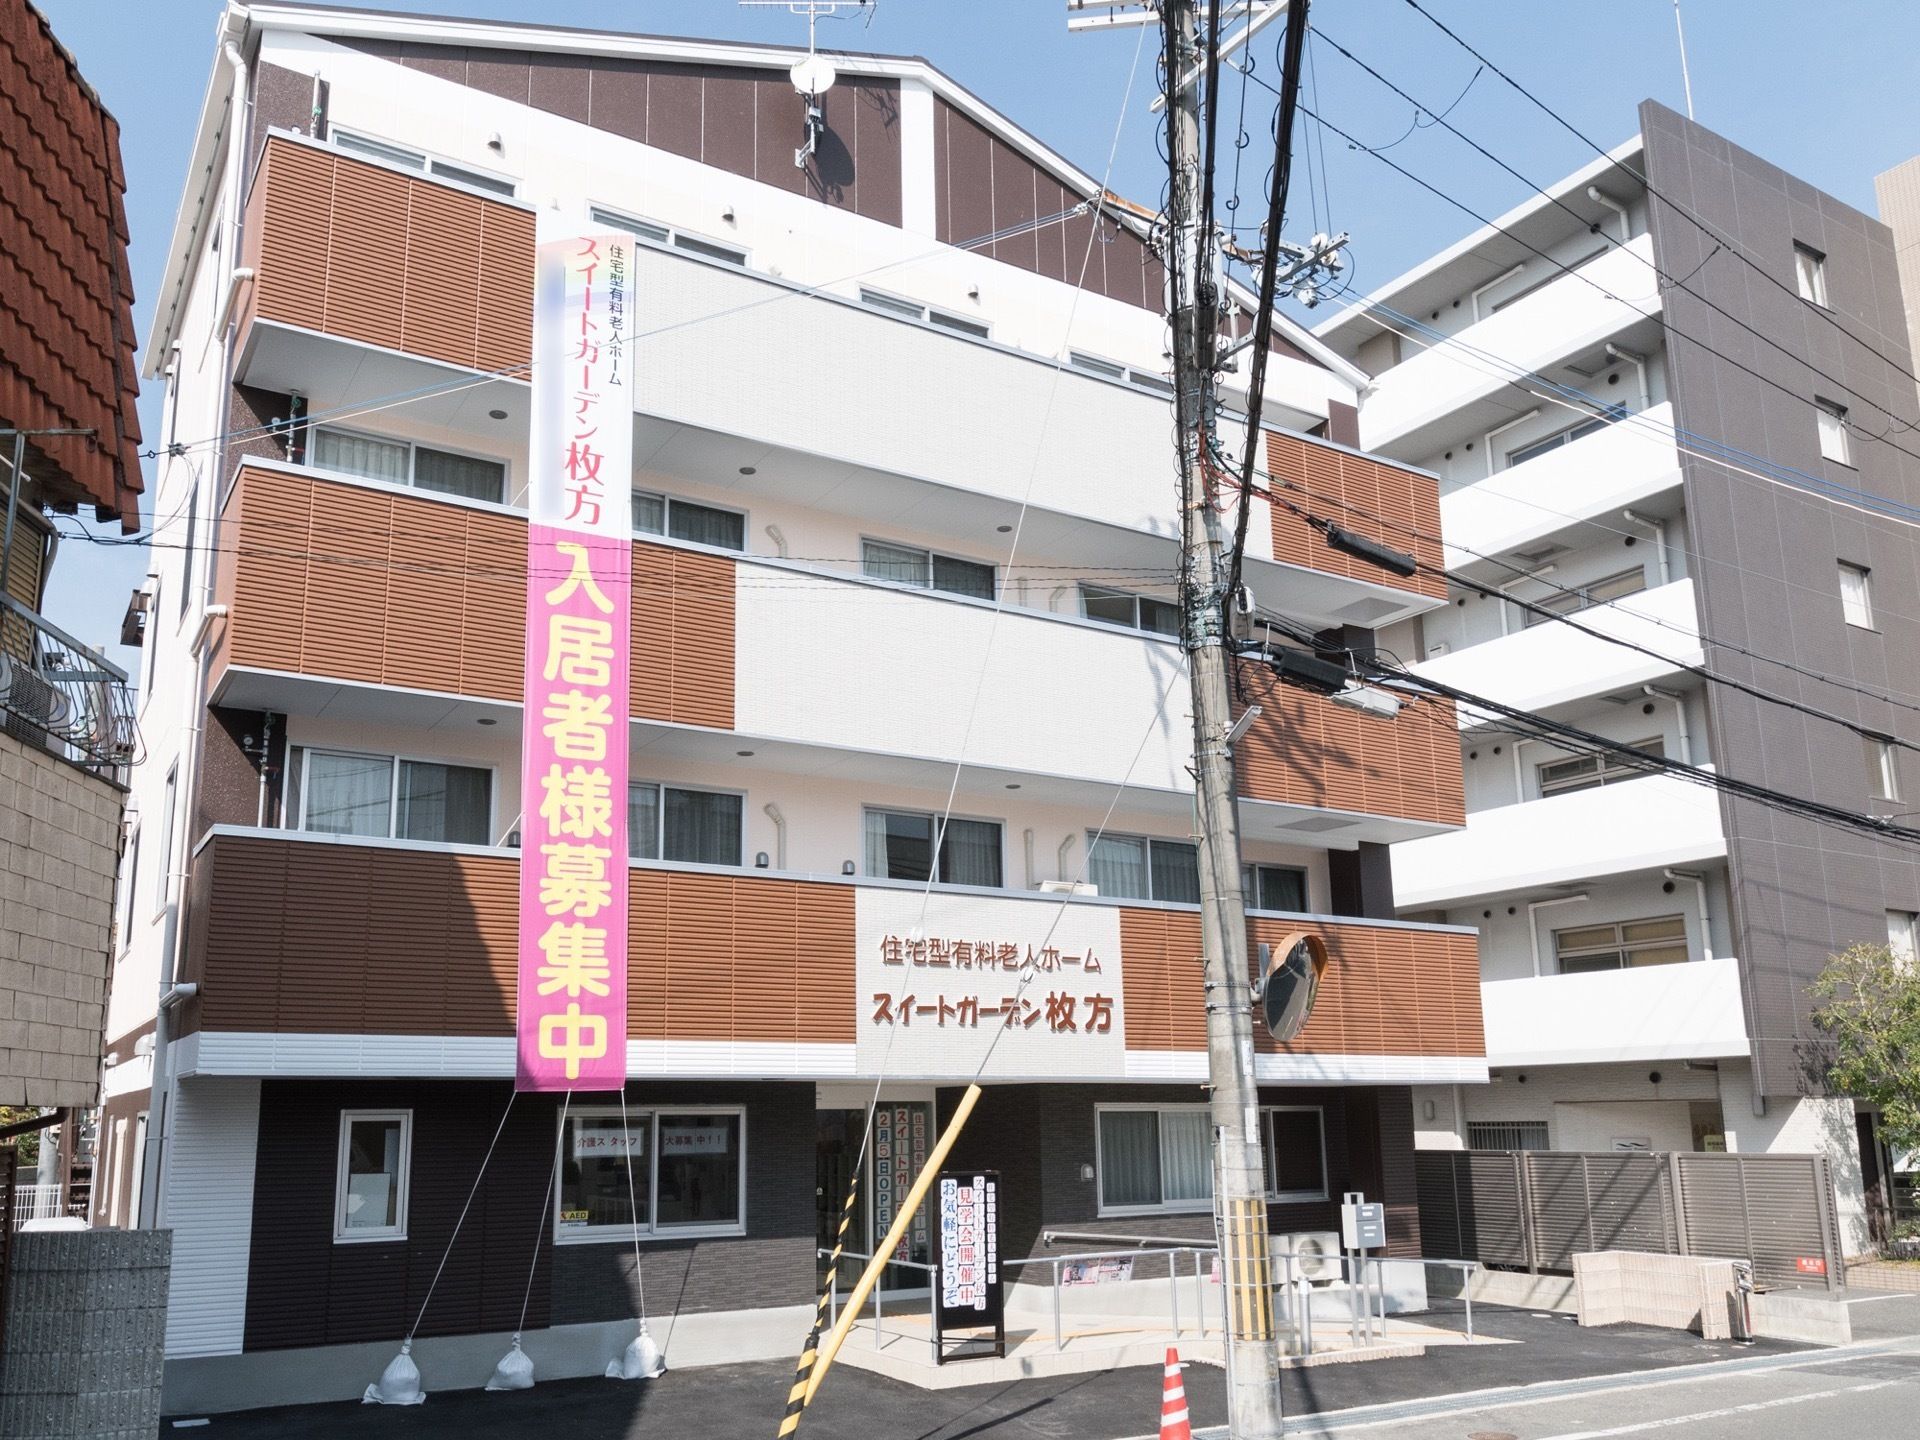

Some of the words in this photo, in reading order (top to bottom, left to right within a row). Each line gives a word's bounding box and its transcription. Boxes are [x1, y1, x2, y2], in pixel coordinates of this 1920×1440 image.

[608, 243, 624, 387] 住宅型有料老人ホーム
[564, 236, 605, 525] スイートガーデン枚方
[537, 540, 615, 1080] 入居者様募集中
[872, 990, 1114, 1032] スイートガーデン枚方
[880, 934, 1102, 974] 住宅型有料老人ホーム
[576, 1136, 638, 1148] 介護スタッフ
[569, 1211, 587, 1220] AED
[943, 1181, 958, 1306] お気軽にどうぞ
[959, 1188, 974, 1304] 見学会開催中
